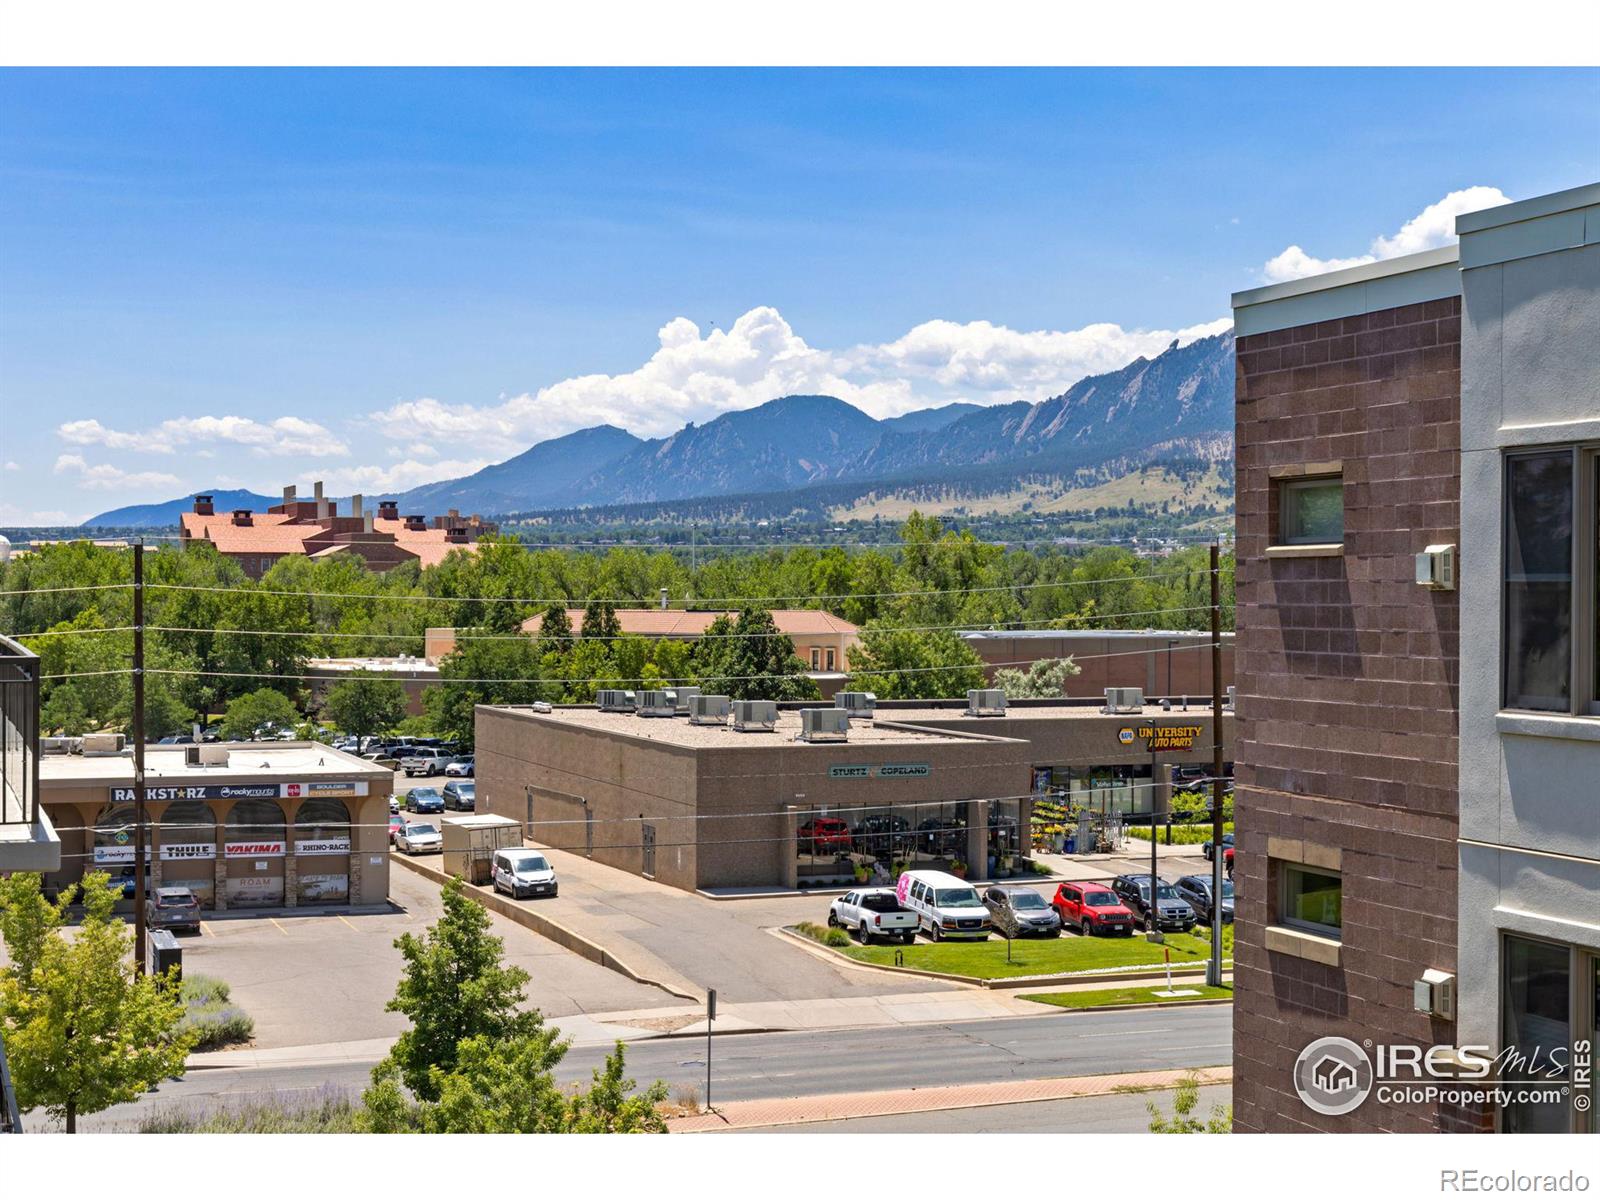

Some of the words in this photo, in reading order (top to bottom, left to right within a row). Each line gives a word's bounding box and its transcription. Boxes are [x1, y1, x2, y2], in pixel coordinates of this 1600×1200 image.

[1170, 737, 1193, 747] PARTS
[832, 768, 868, 776] STURTZ
[880, 767, 928, 775] COPELAND
[230, 788, 274, 796] rockymounts
[166, 846, 210, 857] THULE
[226, 844, 281, 853] YAKIMA
[302, 844, 350, 852] RHINO-RACK
[239, 878, 272, 886] ROAM
